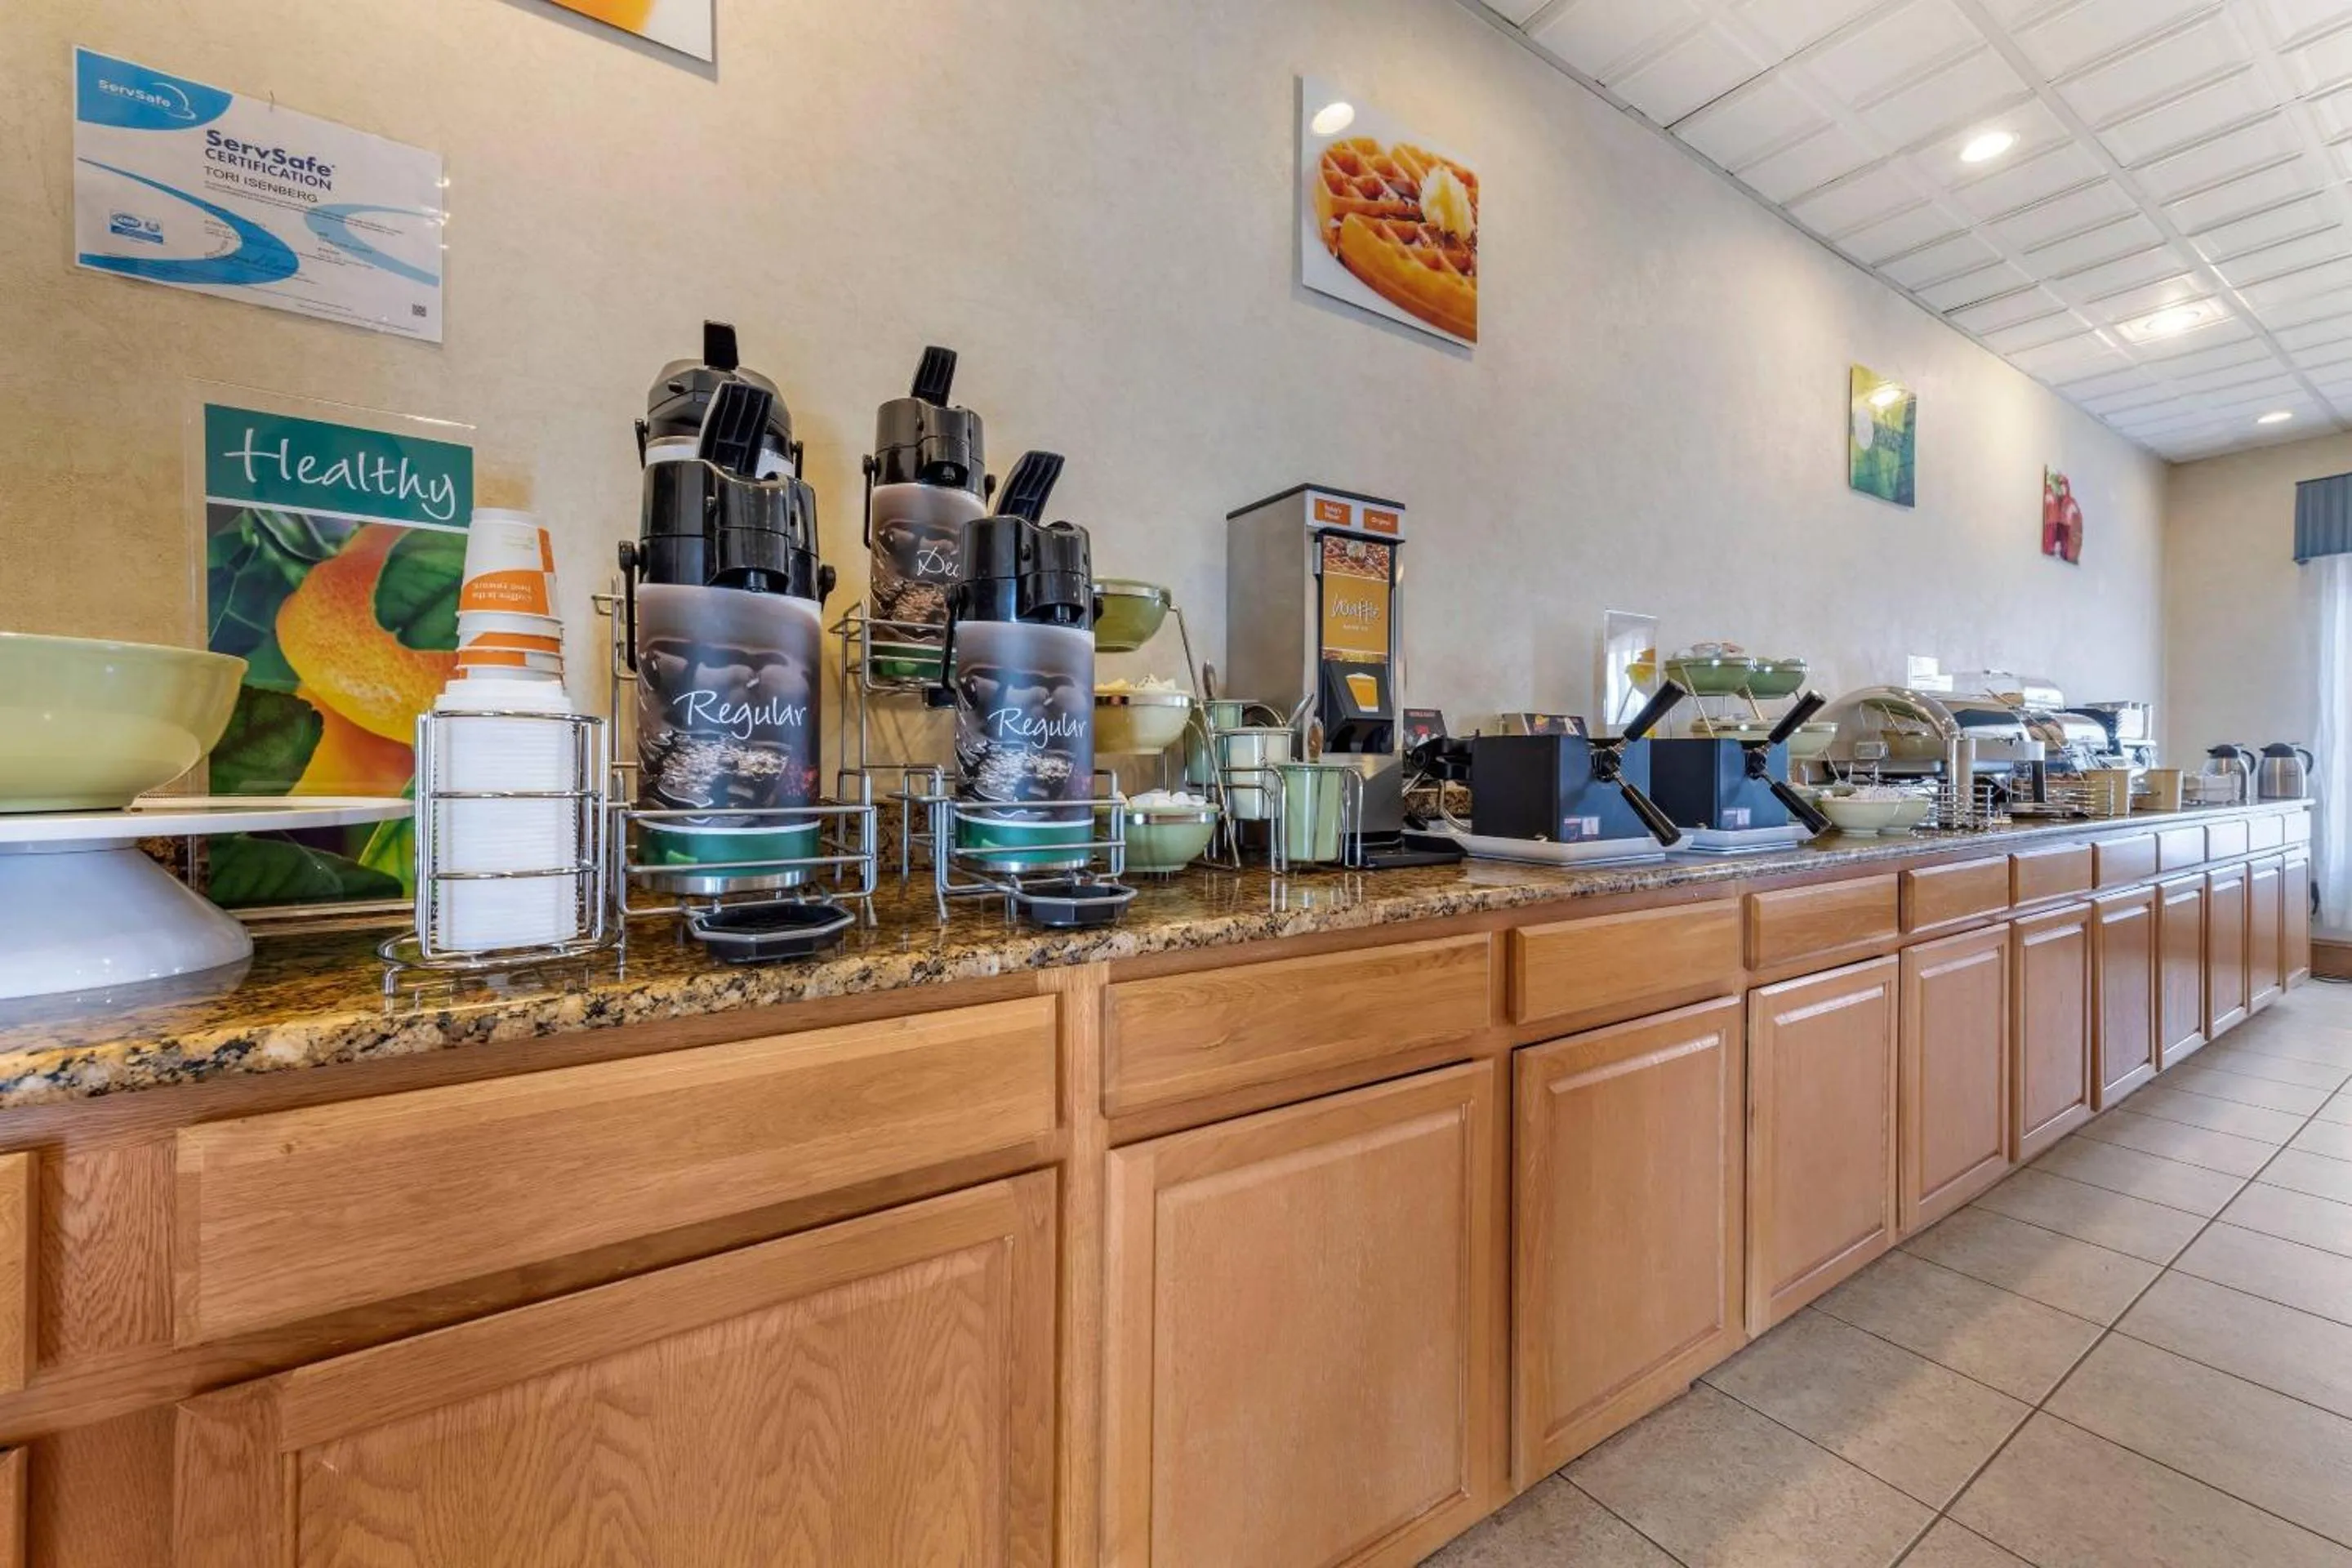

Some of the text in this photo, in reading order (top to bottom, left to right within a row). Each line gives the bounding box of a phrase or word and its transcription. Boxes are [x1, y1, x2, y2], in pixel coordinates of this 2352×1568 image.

[98, 79, 172, 108] ServSafe
[204, 148, 332, 192] CERTIFICATION
[206, 129, 332, 177] ServSafe
[204, 165, 318, 203] TORI ISENBERG
[223, 427, 457, 521] Healthy
[672, 688, 807, 740] Regular
[987, 707, 1087, 749] Regular
